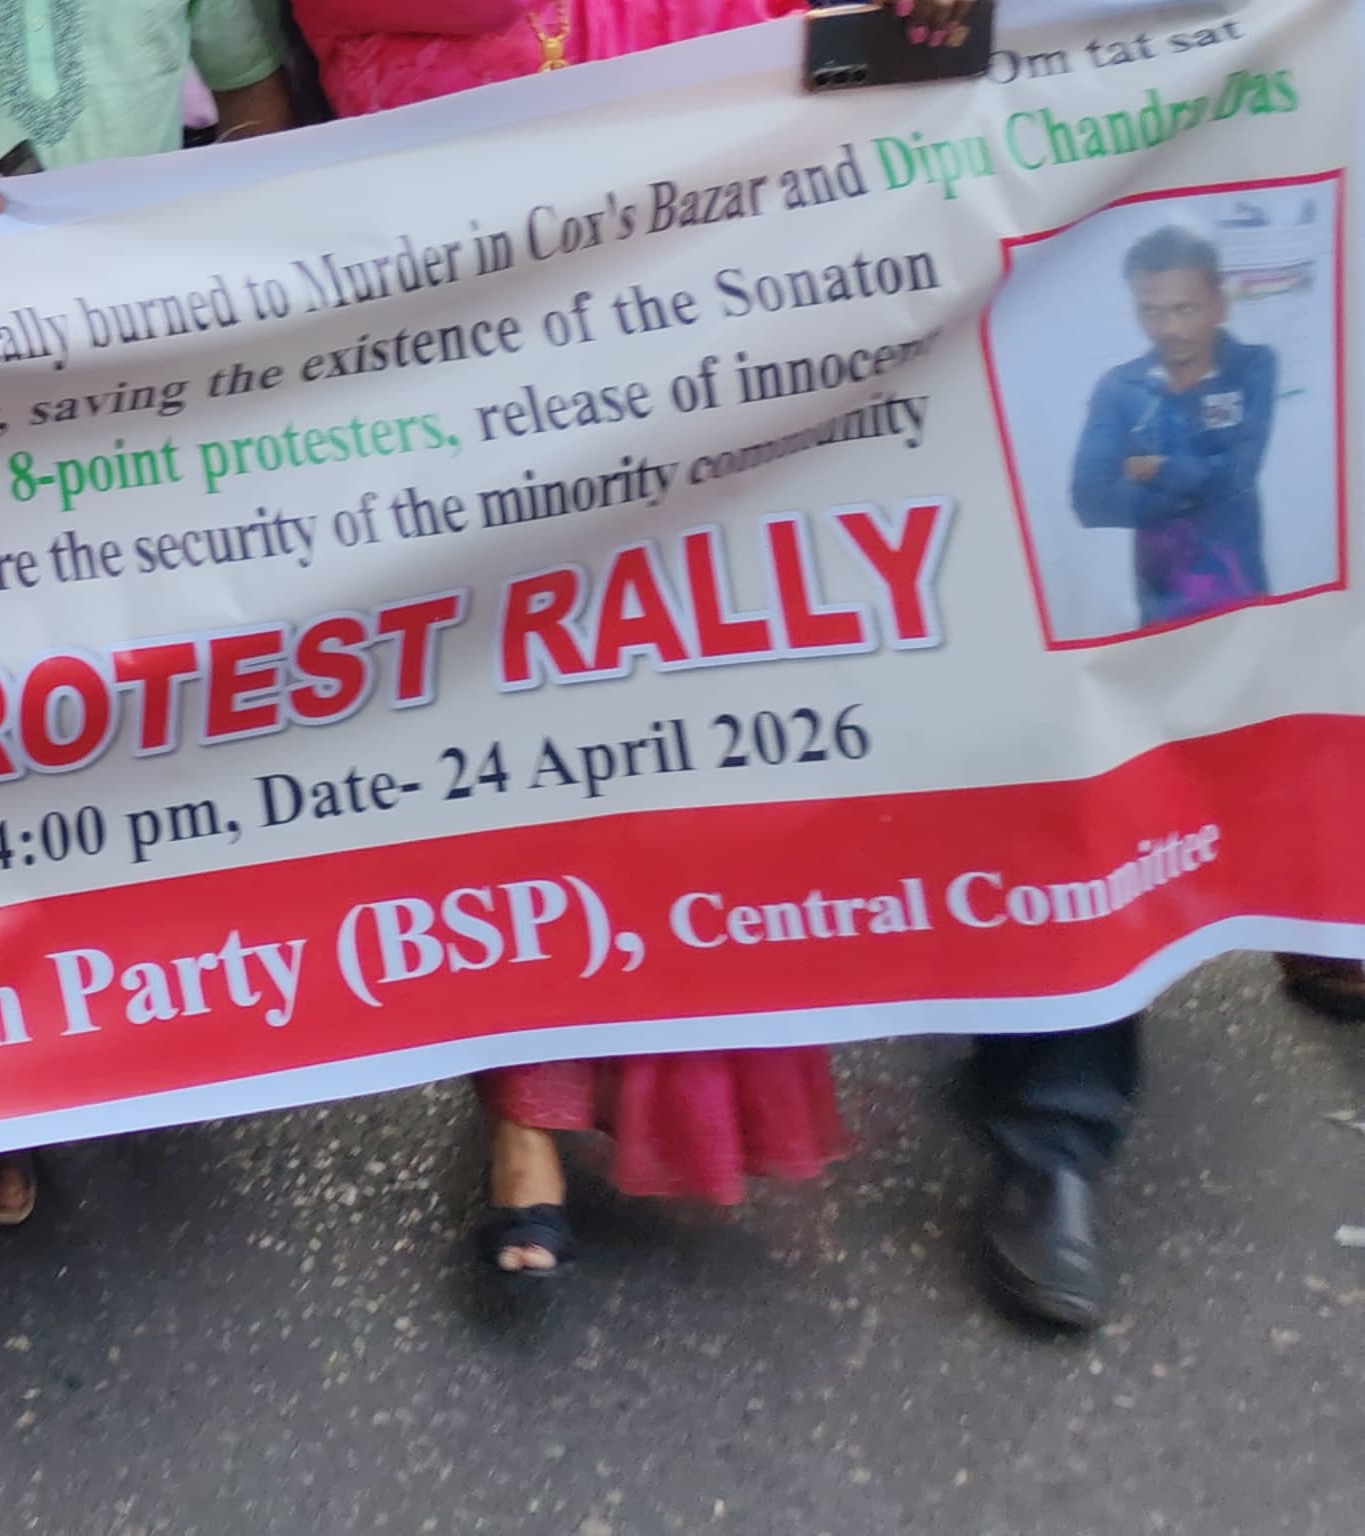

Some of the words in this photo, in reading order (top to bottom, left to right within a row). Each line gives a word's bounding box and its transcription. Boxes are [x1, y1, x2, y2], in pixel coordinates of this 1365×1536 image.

[987, 49, 1069, 84] Om
[1085, 30, 1158, 70] tat
[1166, 19, 1246, 55] sat
[74, 272, 238, 348] burned
[244, 271, 291, 322] to
[291, 231, 463, 314] Murder
[471, 219, 513, 278] in
[647, 175, 769, 235] Bazar
[779, 143, 870, 212] and
[871, 130, 997, 200] Dipu
[27, 379, 189, 428] saving
[208, 363, 285, 398] the
[300, 312, 523, 383] existence
[544, 290, 592, 347] of
[612, 283, 700, 337] the
[714, 249, 944, 319] Sonaton
[7, 437, 184, 511] 8-point
[195, 413, 463, 494] protesters,
[476, 381, 654, 443] release
[670, 354, 720, 414] of
[49, 530, 125, 584] the
[133, 504, 318, 573] security
[333, 491, 379, 550] of
[390, 484, 468, 538] the
[479, 457, 680, 531] minority
[498, 500, 948, 687] RALLY
[126, 795, 242, 863] pm,
[255, 770, 422, 828] Date-
[440, 741, 509, 802] 24
[528, 720, 694, 800] April
[714, 704, 873, 769] 2026
[46, 929, 309, 1037] Party
[335, 874, 646, 1007] (BSP),
[669, 878, 932, 950] Central
